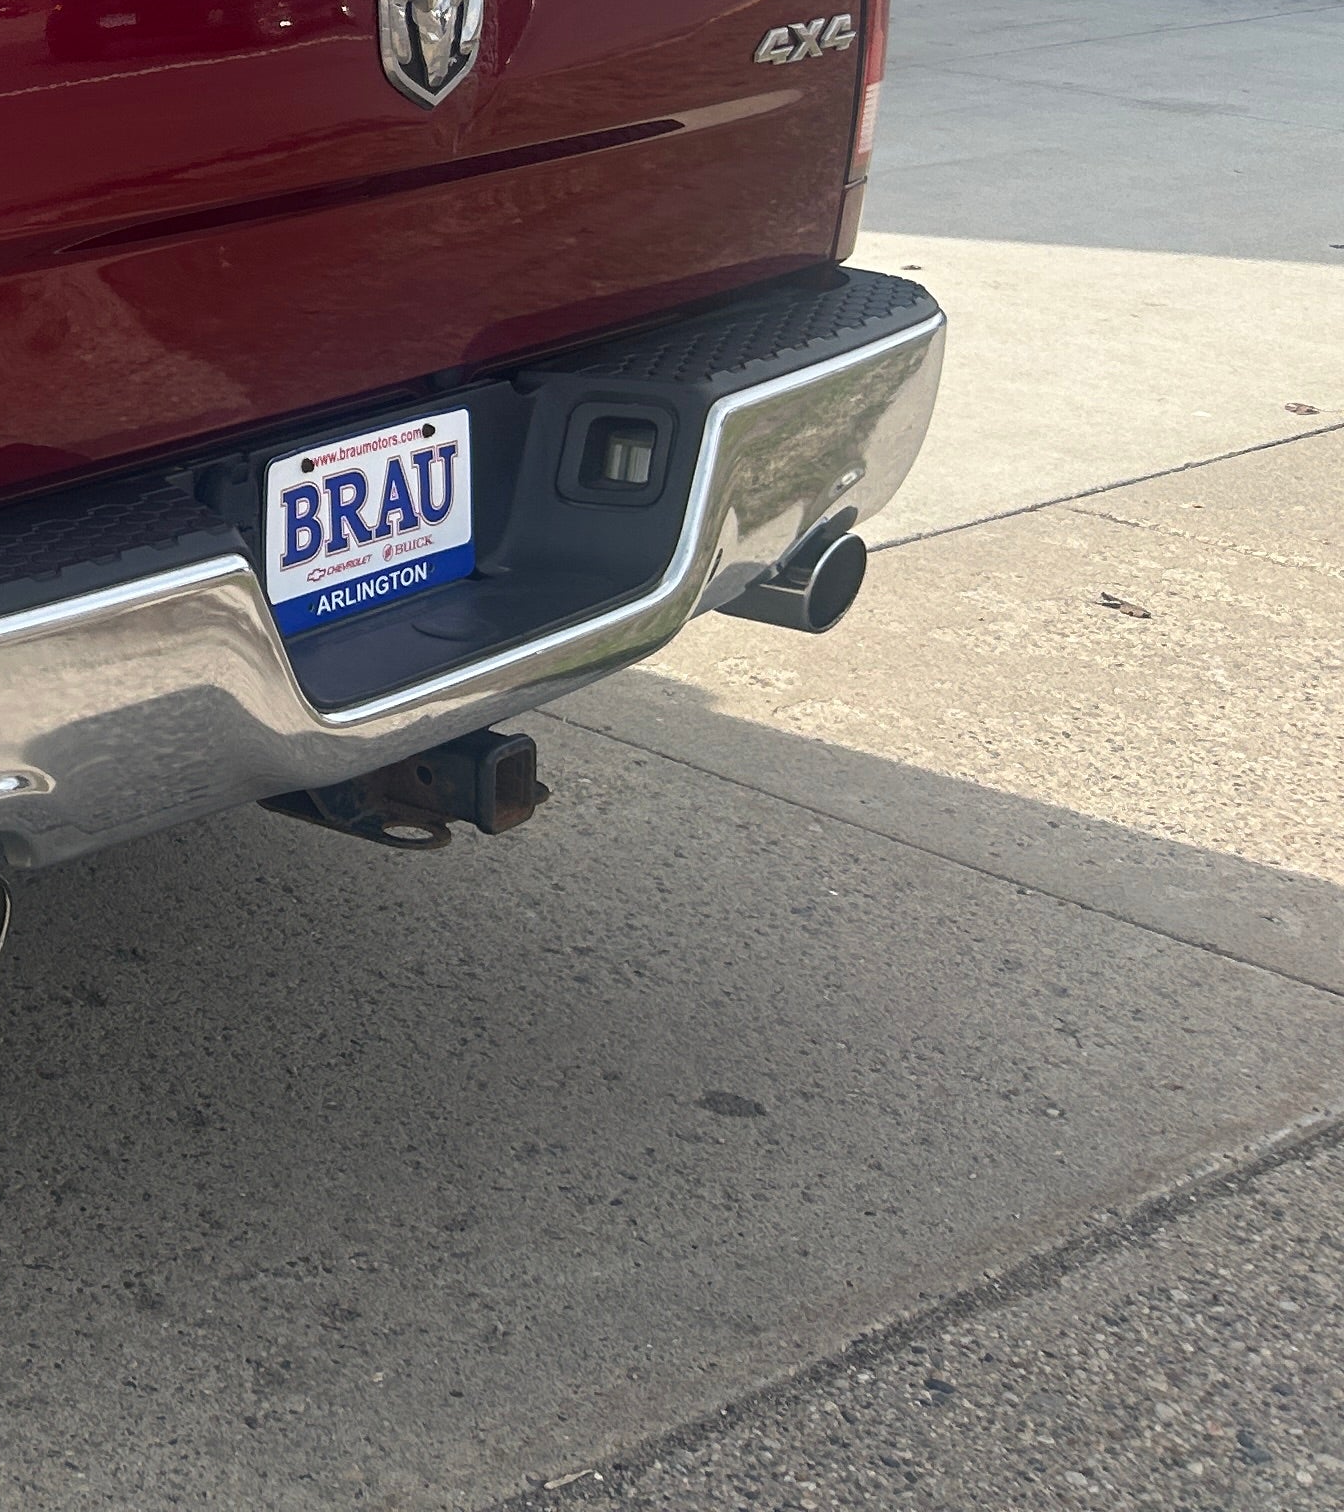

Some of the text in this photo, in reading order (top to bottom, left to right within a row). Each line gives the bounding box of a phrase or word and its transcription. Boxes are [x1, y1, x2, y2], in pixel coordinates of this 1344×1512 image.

[311, 426, 423, 468] www.braumotors.com
[280, 440, 459, 571] BRAU
[325, 534, 434, 576] CHEVROLET BUICK
[316, 561, 428, 616] ARLINGTON
